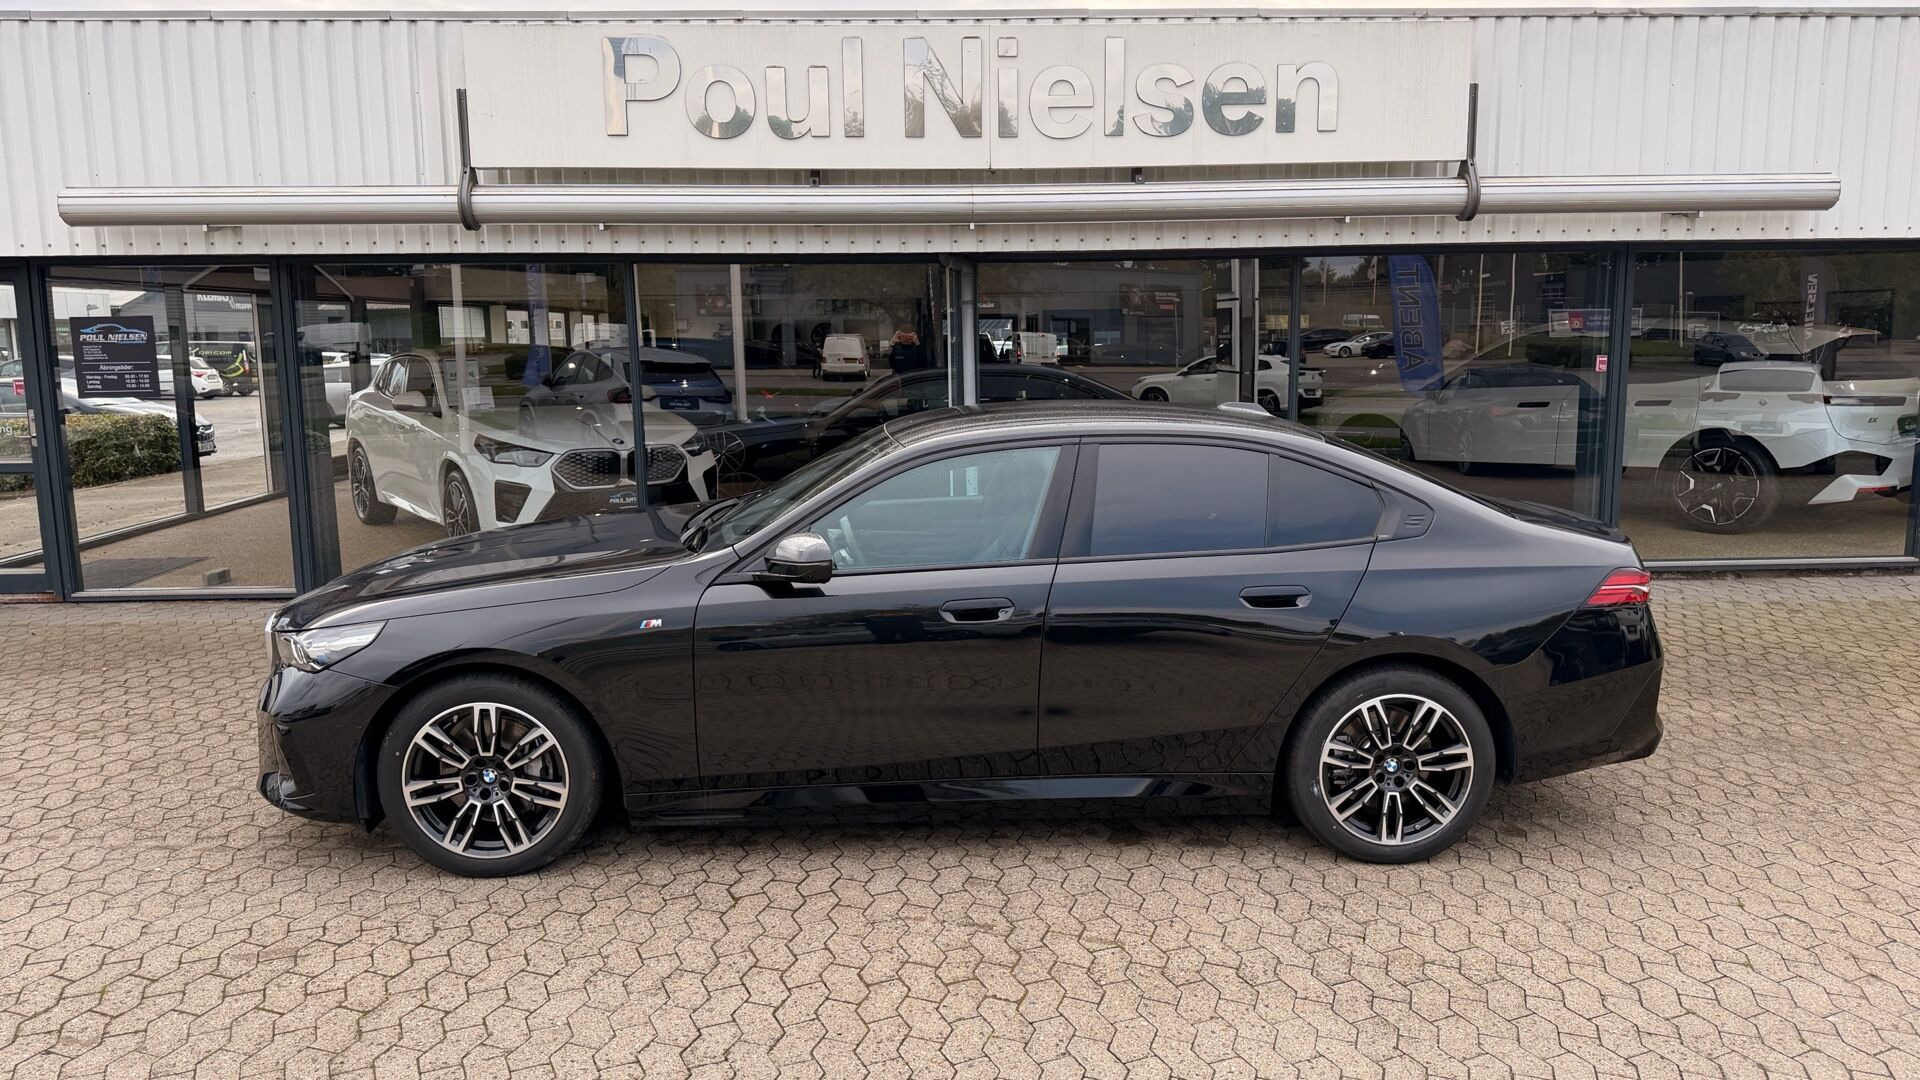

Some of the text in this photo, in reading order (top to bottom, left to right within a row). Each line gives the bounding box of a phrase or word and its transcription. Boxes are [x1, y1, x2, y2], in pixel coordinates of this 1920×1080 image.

[602, 36, 1339, 140] Poul Nielsen
[80, 332, 147, 341] POUL NIELSEN
